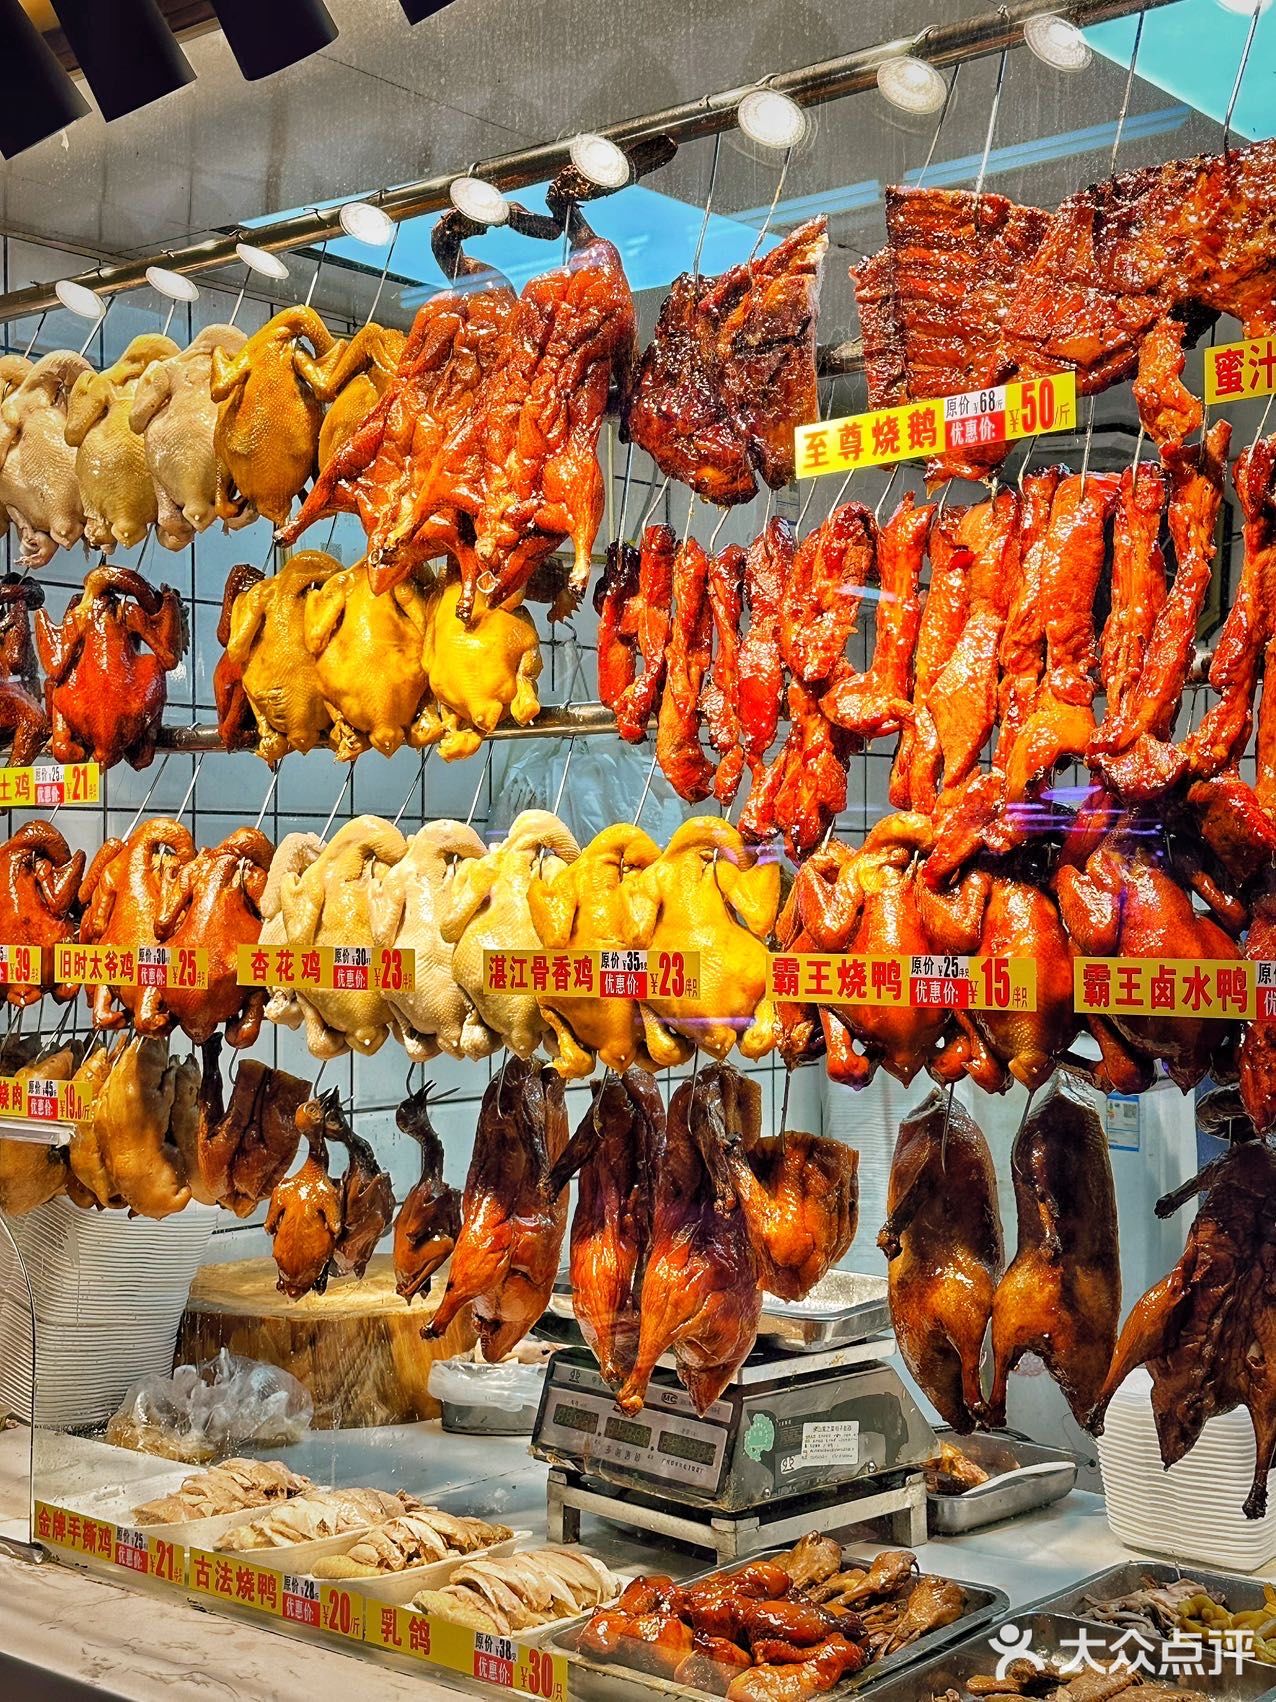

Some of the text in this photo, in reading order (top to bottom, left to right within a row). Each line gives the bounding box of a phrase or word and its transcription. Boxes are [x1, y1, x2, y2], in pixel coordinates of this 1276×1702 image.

[803, 407, 937, 469] 至尊烧鹅
[60, 949, 134, 982] 旧时太爷鸡
[251, 949, 321, 983] 杏花鸡
[489, 954, 593, 992] 湛江骨香鸡
[772, 957, 902, 1001] 霸王烧鸭
[1083, 963, 1248, 1013] 霸王卤水鸭
[916, 979, 959, 1005] 优惠价:
[38, 1506, 112, 1558] 金牌手撕鸡
[194, 1555, 277, 1609] 古法烧鸭
[381, 1607, 431, 1656] 乳鸽
